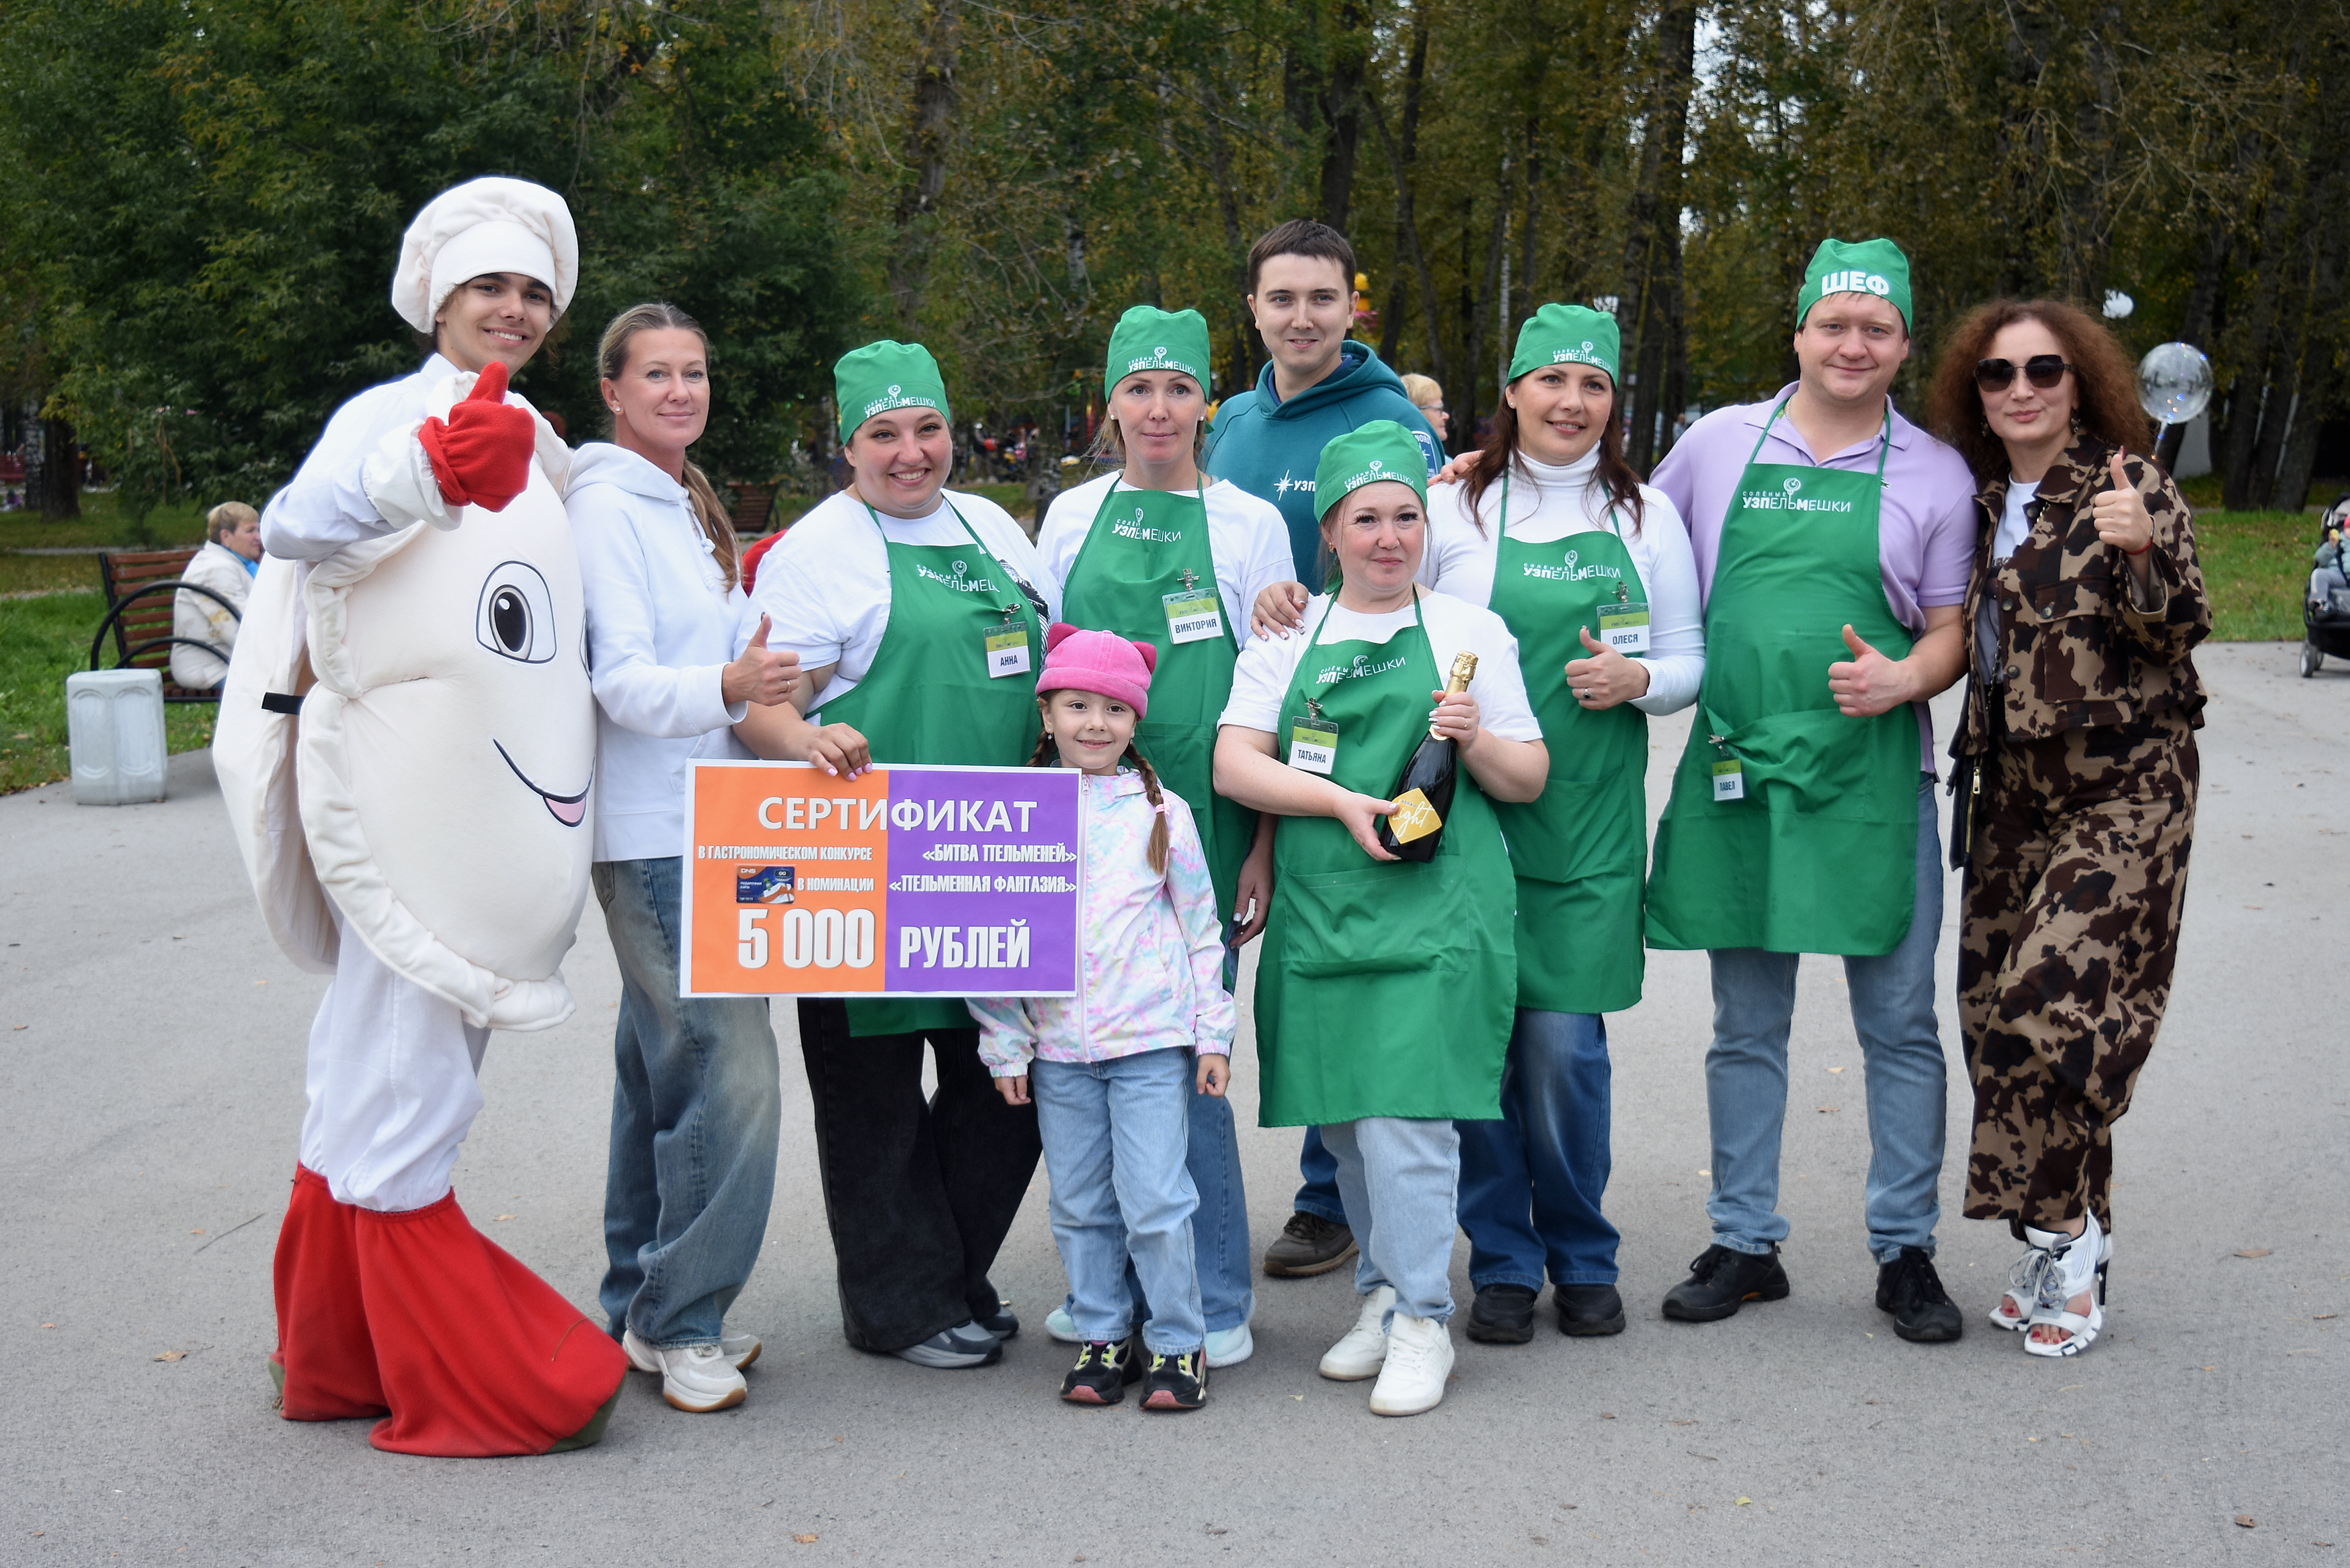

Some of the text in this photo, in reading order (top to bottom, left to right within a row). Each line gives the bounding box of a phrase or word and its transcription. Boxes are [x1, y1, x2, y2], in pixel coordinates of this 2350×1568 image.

[1822, 271, 1889, 296] ШЕФ
[1129, 360, 1196, 376] УЗПЕЛЬМЕШКИ
[864, 397, 936, 418] УЗПЕЛЬМЕШКИ
[1345, 471, 1414, 492] УЗПЕЛЬМЕШКИ
[1742, 497, 1851, 512] УЗПЕЛЬМЕШКИ
[1523, 565, 1621, 581] УЗПЕЛЬМЕШКИ
[1175, 618, 1217, 634] ВИКТОРИЯ
[1613, 633, 1638, 645] ОЛЕСЯ
[1000, 655, 1018, 667] АННА
[1298, 749, 1326, 764] ТАТЬЯНА
[1719, 780, 1736, 792] ПАВЕЛ
[758, 796, 1038, 833] СЕРТИФИКАТ
[1392, 798, 1435, 837] Light
[698, 842, 1078, 863] В ГАСТРОНОМИЧЕСКОМ КОНКУРСЕ «БИТВА ПЕЛЬМЕНЕЙ»
[797, 874, 1077, 893] В НОМИНАЦИИ «ПЕЛЬМЕННАЯ ФАНТАЗИЯ»
[738, 908, 1030, 968] 5 000 РУБЛЕЙ
